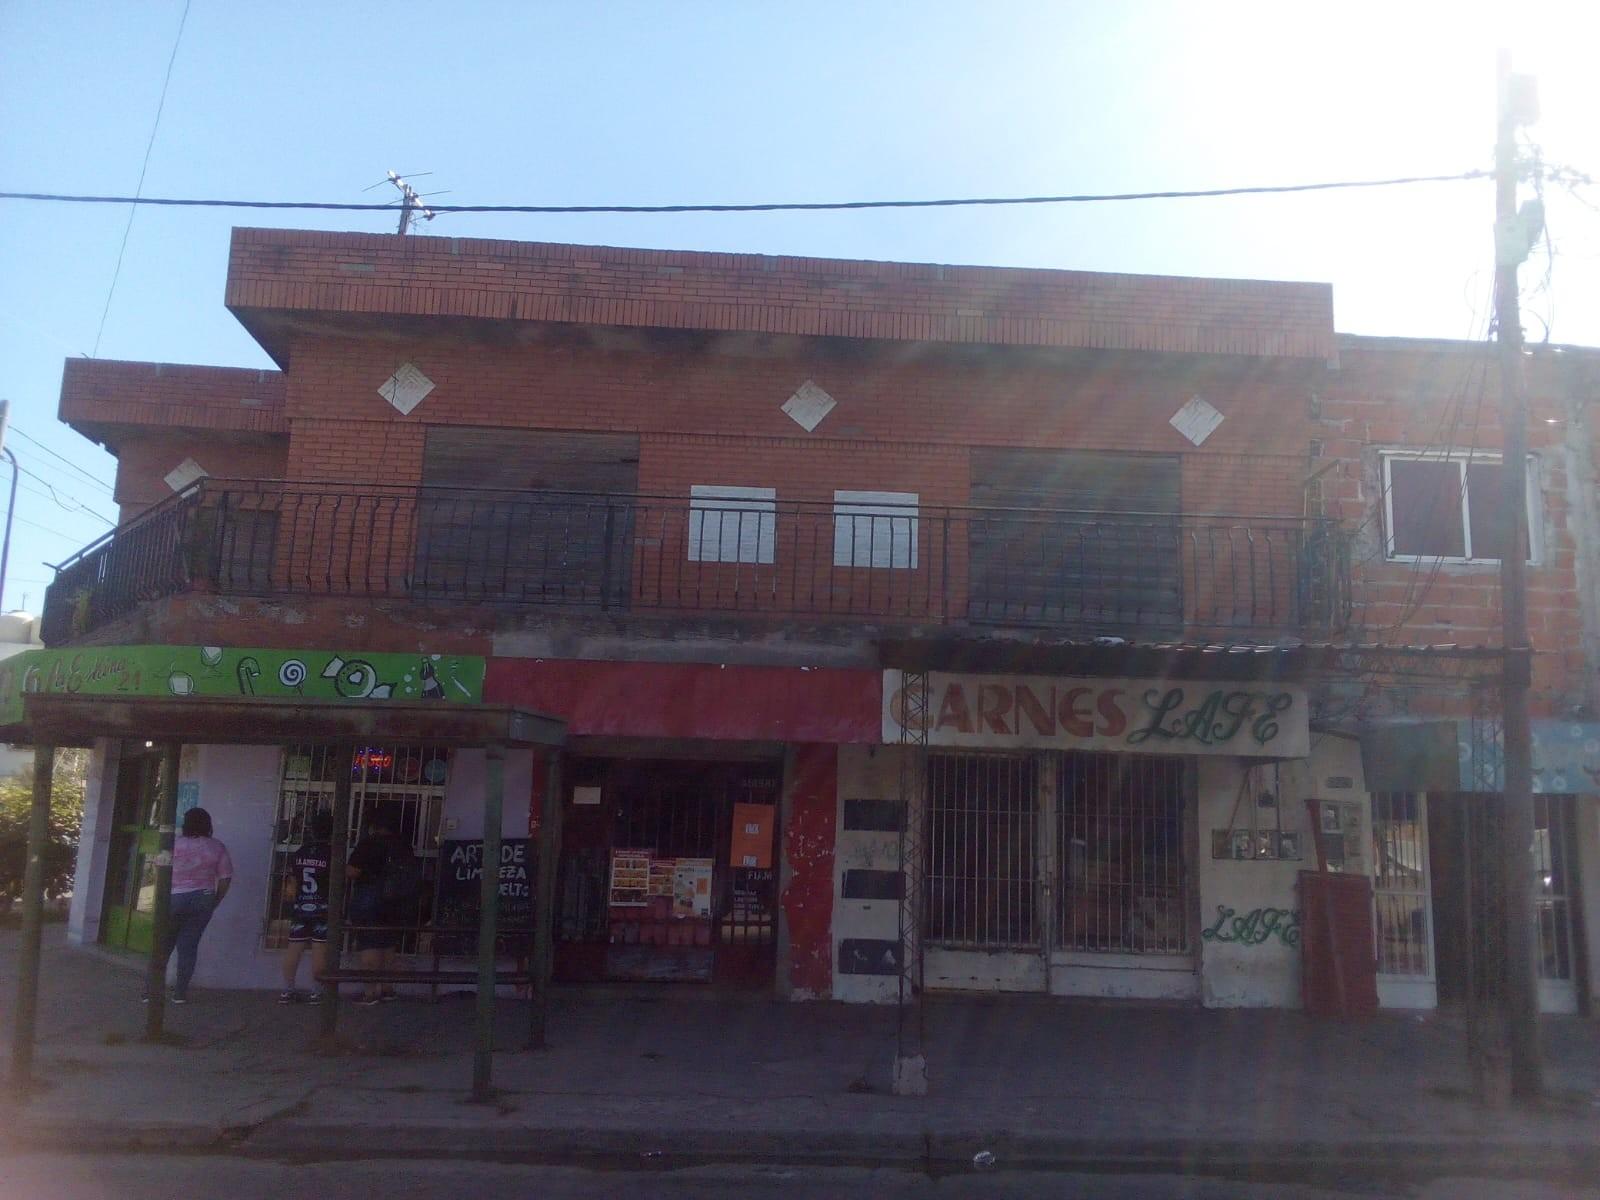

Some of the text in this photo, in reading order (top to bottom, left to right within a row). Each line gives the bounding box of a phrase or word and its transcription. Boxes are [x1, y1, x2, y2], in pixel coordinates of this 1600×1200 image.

[889, 682, 1128, 738] CARNES
[501, 844, 526, 863] DE
[302, 866, 318, 894] 5
